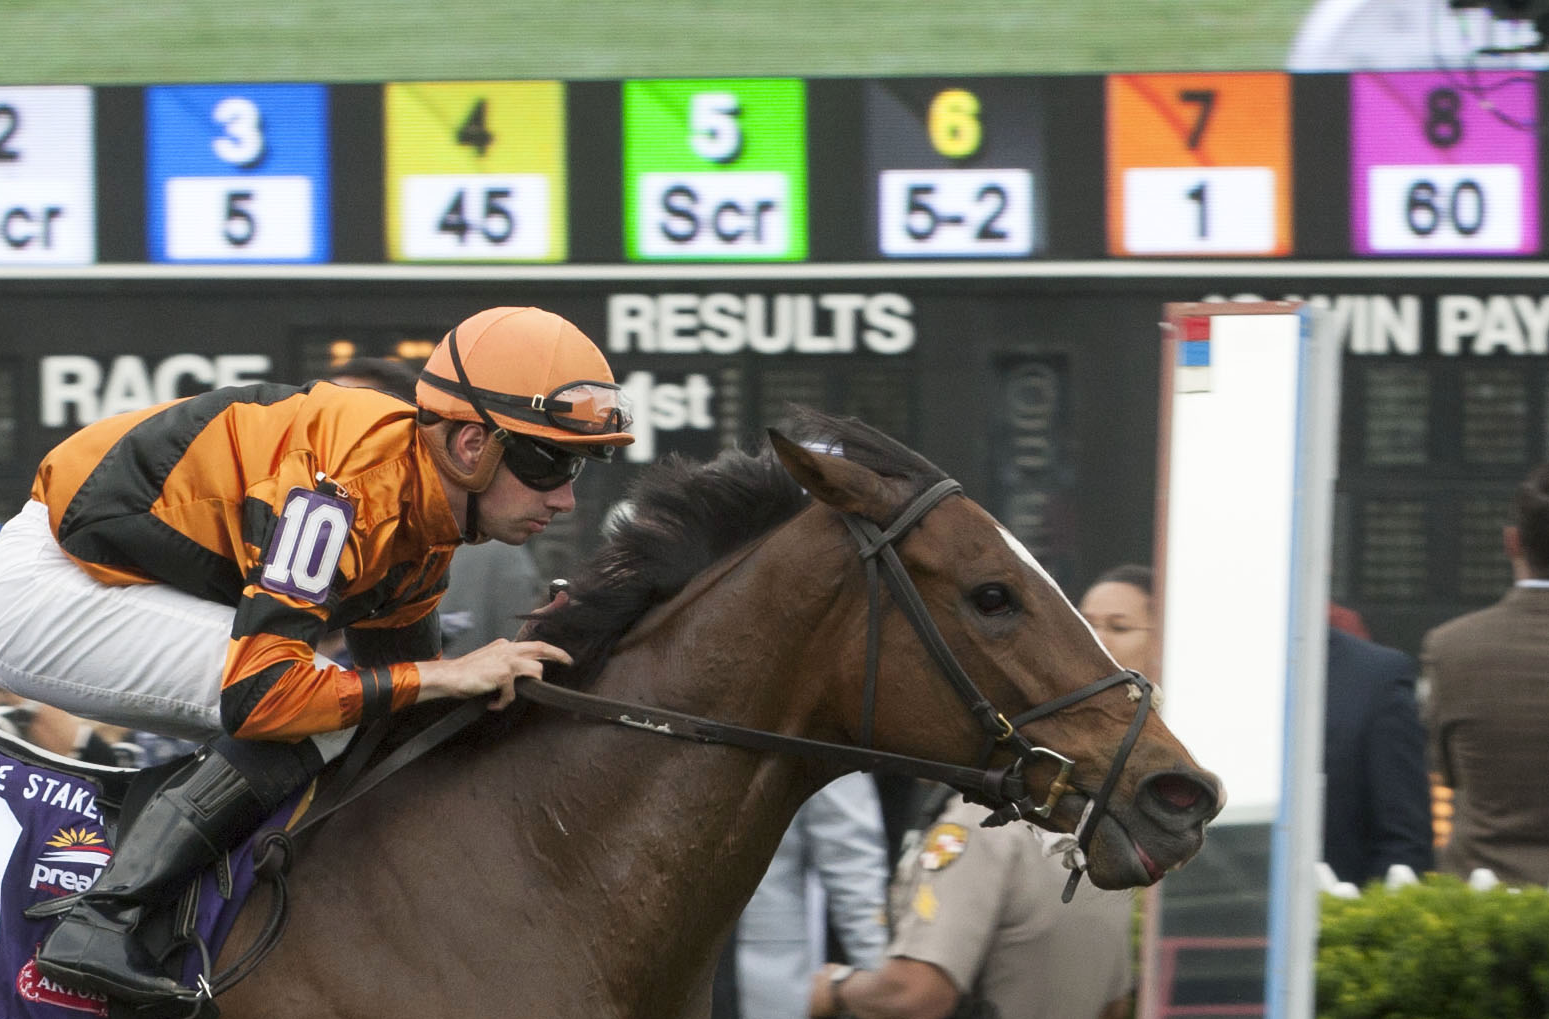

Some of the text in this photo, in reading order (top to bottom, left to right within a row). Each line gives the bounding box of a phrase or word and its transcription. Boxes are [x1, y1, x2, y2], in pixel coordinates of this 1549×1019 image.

[211, 98, 266, 167] 3
[455, 97, 494, 158] 4
[687, 92, 744, 164] 5
[928, 89, 982, 159] 6
[1178, 90, 1218, 151] 7
[1424, 88, 1462, 149] 8
[222, 191, 256, 246] 5
[437, 186, 515, 246] 45
[660, 185, 777, 245] Scr
[903, 184, 1009, 242] 5-2
[1186, 180, 1209, 241] 1
[1405, 179, 1487, 238] 60
[608, 293, 916, 355] RESULTS
[1284, 294, 1422, 354] IN
[623, 370, 715, 464] 1st
[260, 495, 351, 596] 10
[22, 772, 105, 827] STAKE
